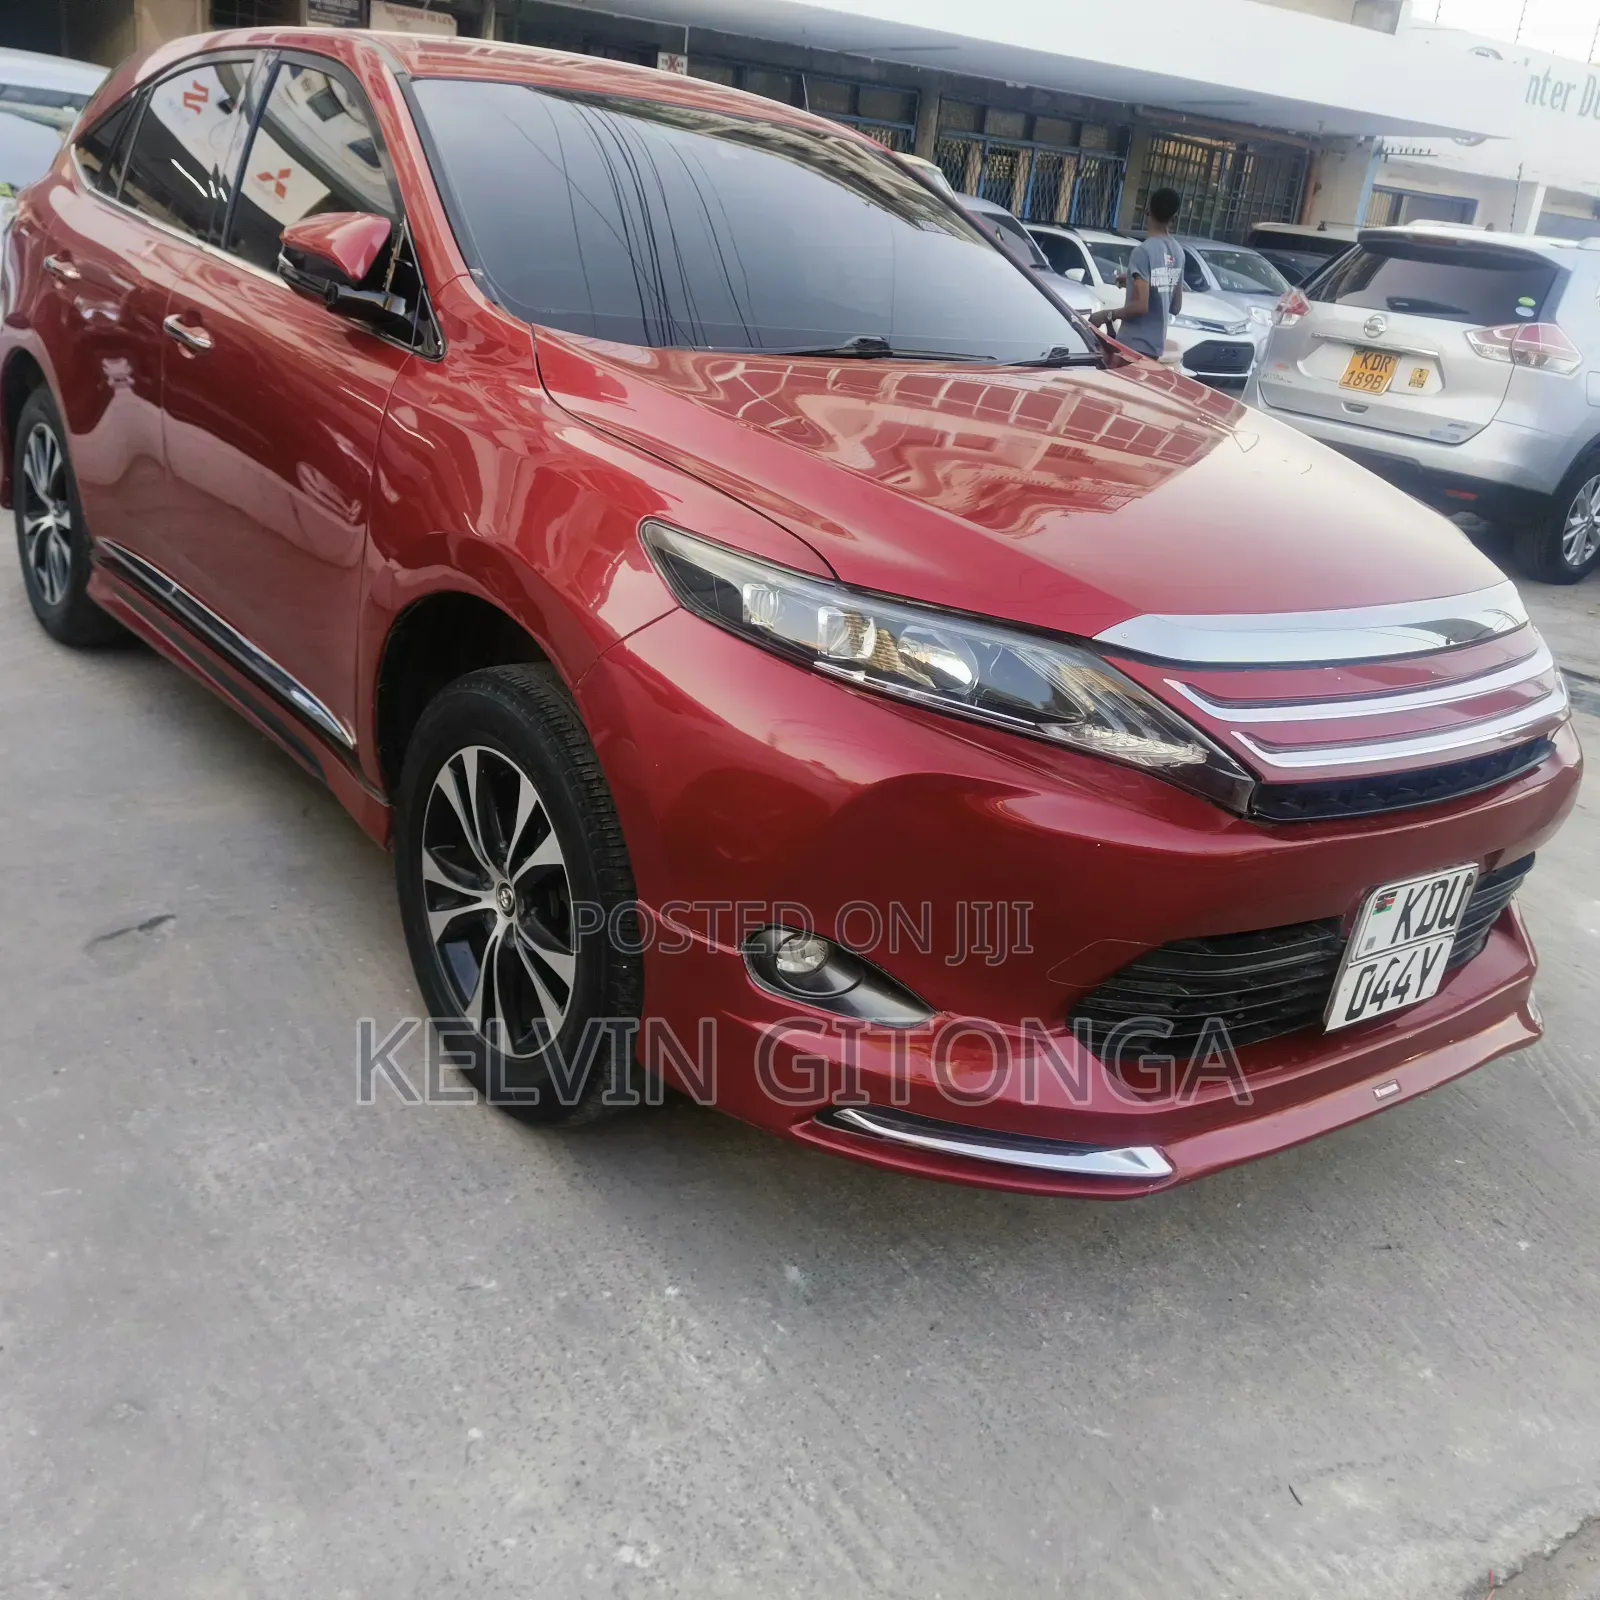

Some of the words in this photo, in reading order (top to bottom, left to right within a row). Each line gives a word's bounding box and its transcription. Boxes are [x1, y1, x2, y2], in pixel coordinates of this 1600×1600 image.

[1523, 58, 1577, 113] nter
[1360, 352, 1392, 373] KDR
[1391, 872, 1475, 944] KDU
[1344, 942, 1443, 1022] 044Y
